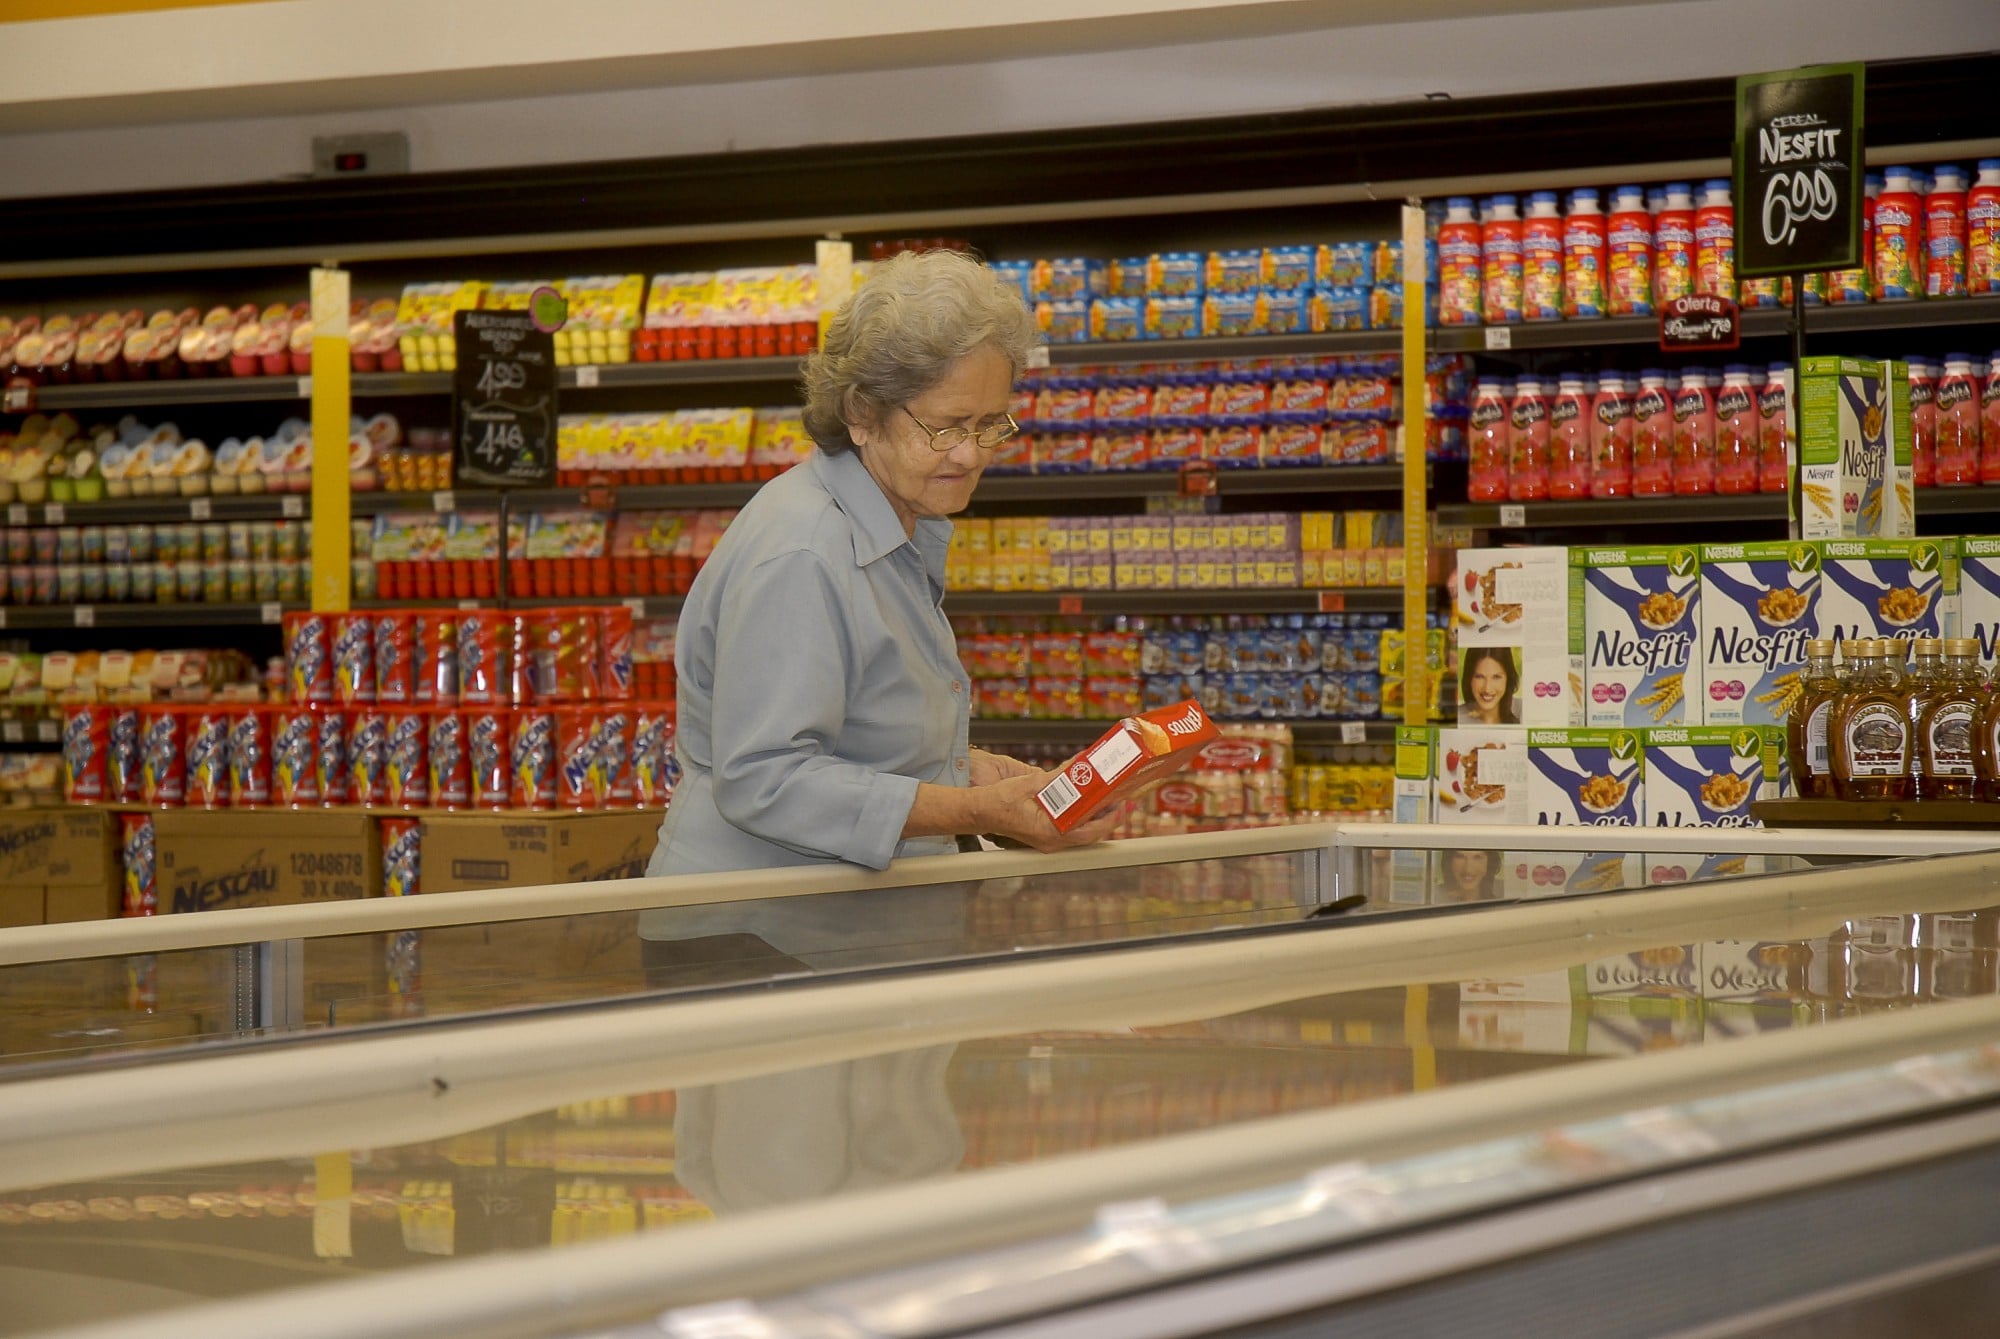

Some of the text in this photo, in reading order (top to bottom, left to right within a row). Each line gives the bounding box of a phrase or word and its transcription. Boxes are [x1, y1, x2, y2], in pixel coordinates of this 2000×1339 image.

[1759, 128, 1841, 165] NESFIT
[1675, 297, 1721, 313] Oferta
[1807, 468, 1836, 480] Nesfit
[1842, 439, 1885, 485] Nesfit
[1591, 629, 1691, 675] Nesfit
[1708, 625, 1812, 672] Nesfit
[172, 866, 278, 914] NESCAU
[319, 879, 329, 897] X
